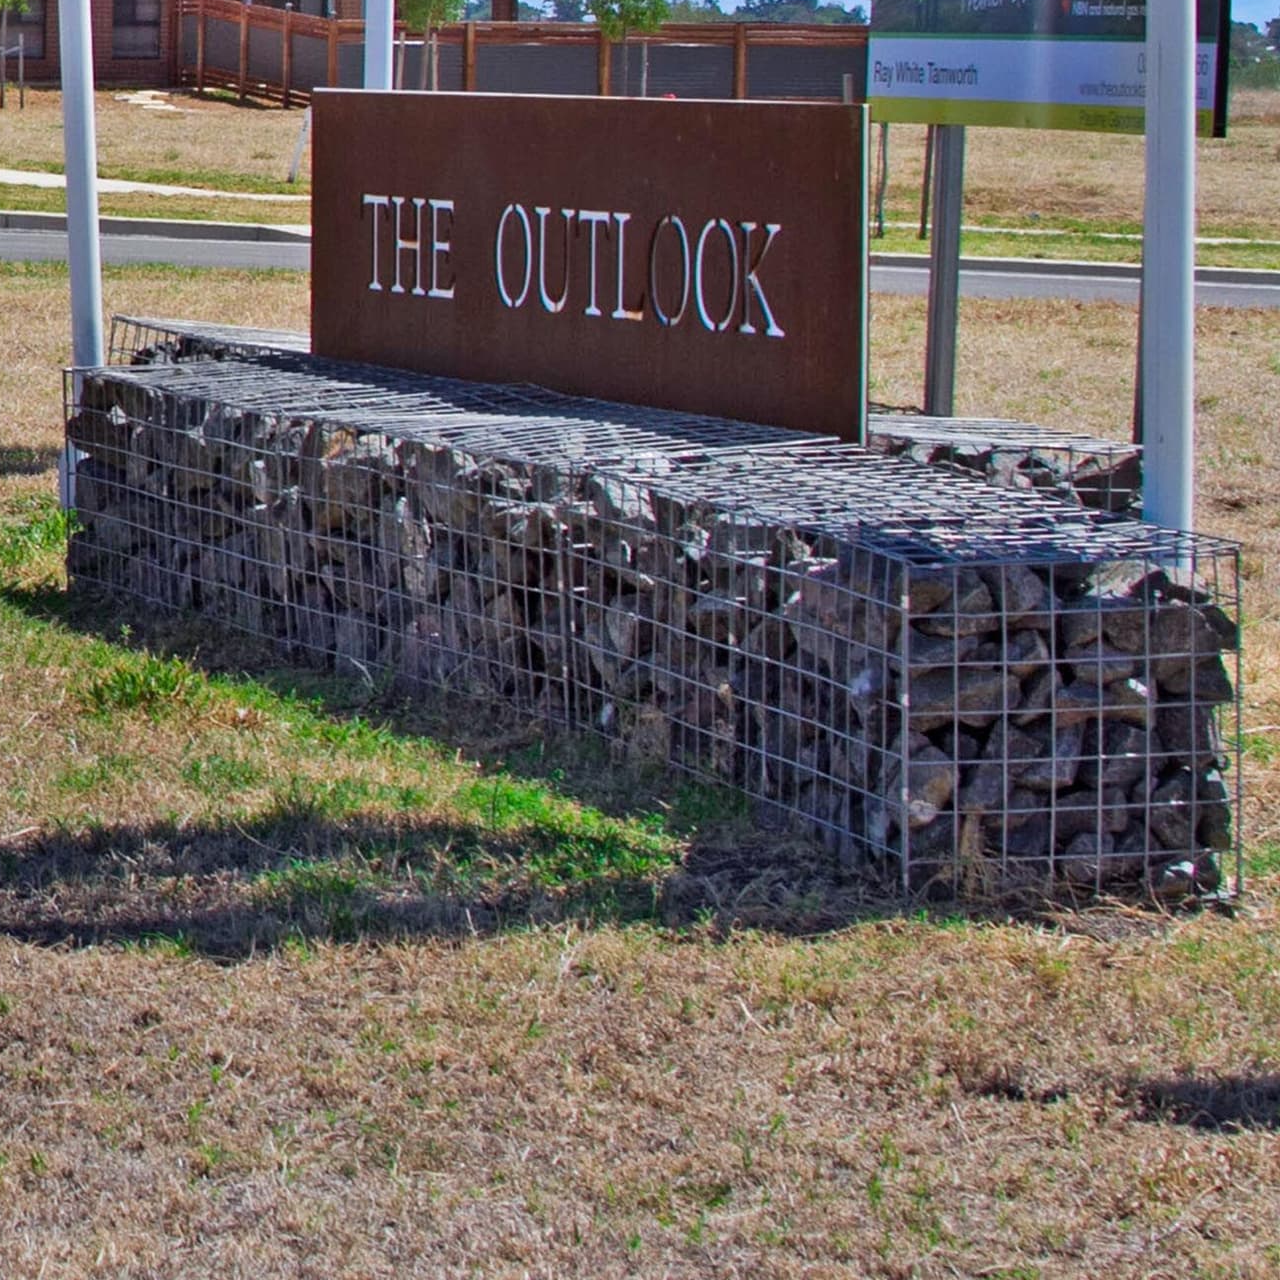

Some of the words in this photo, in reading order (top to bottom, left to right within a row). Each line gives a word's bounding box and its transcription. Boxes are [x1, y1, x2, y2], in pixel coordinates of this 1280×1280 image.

[873, 61, 894, 89] Ray
[895, 60, 925, 85] White
[927, 61, 979, 87] Tamworth
[361, 193, 456, 300] THE
[496, 203, 785, 337] OUTLOOK
